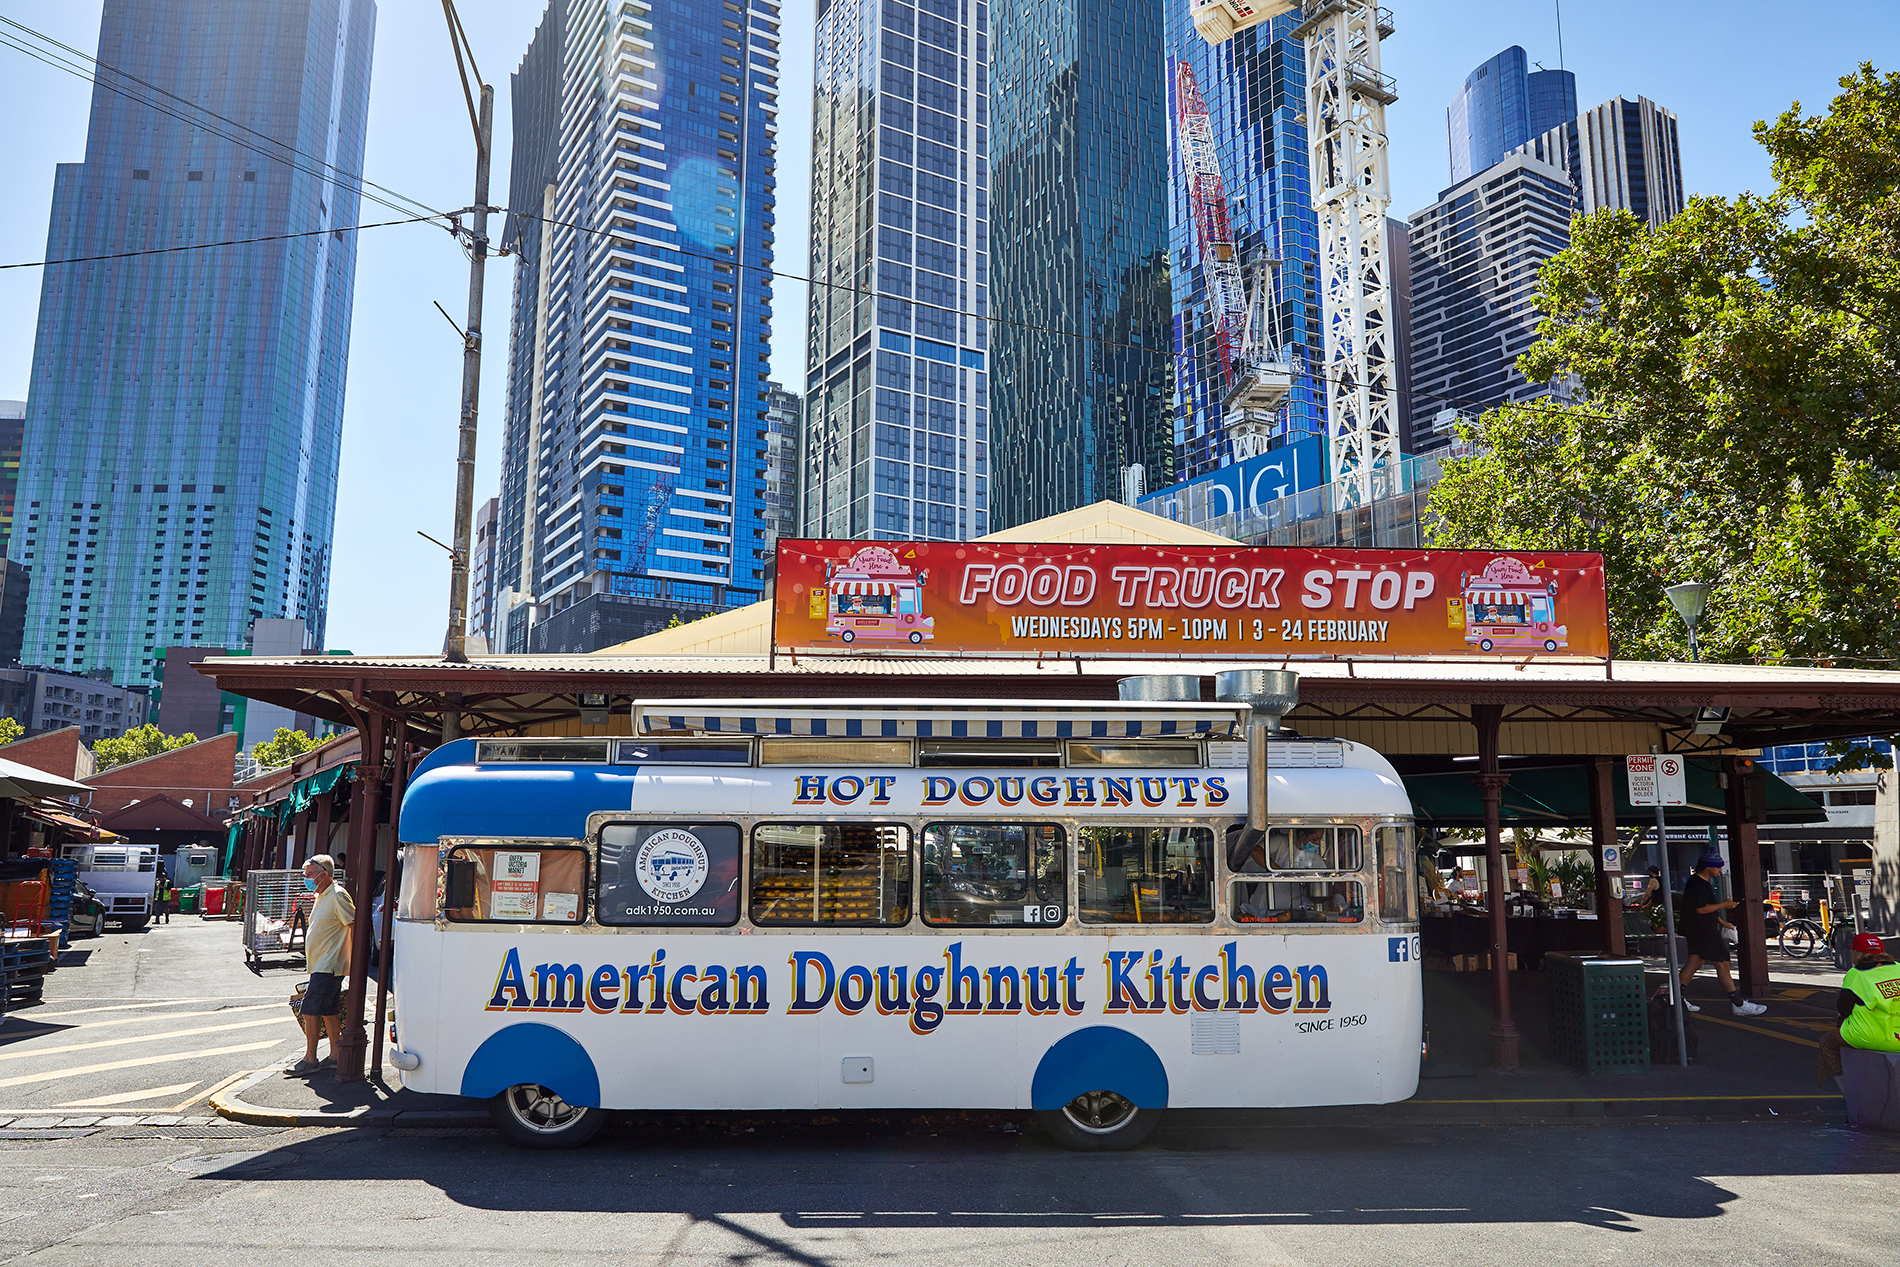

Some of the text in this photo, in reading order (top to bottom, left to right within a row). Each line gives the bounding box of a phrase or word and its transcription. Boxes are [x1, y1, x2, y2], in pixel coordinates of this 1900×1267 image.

[1508, 565, 1523, 574] Food
[960, 564, 1435, 609] FOOD TRUCK STOP
[1011, 616, 1122, 639] WEDNESDAYS
[1128, 617, 1164, 640] 5PM
[1181, 618, 1228, 641] 10PM
[1253, 618, 1263, 640] 3
[1282, 619, 1303, 641] 24
[1308, 619, 1389, 642] FEBRUARY
[792, 775, 1230, 808] HOT DOUGHNUTS
[638, 832, 706, 871] AMERICAN DOUGHNUT
[651, 887, 691, 900] KITCHEN
[625, 905, 716, 916] adk1950.com.au
[484, 941, 1332, 1035] American Doughnut Kitchen
[1339, 1013, 1368, 1028] 1950
